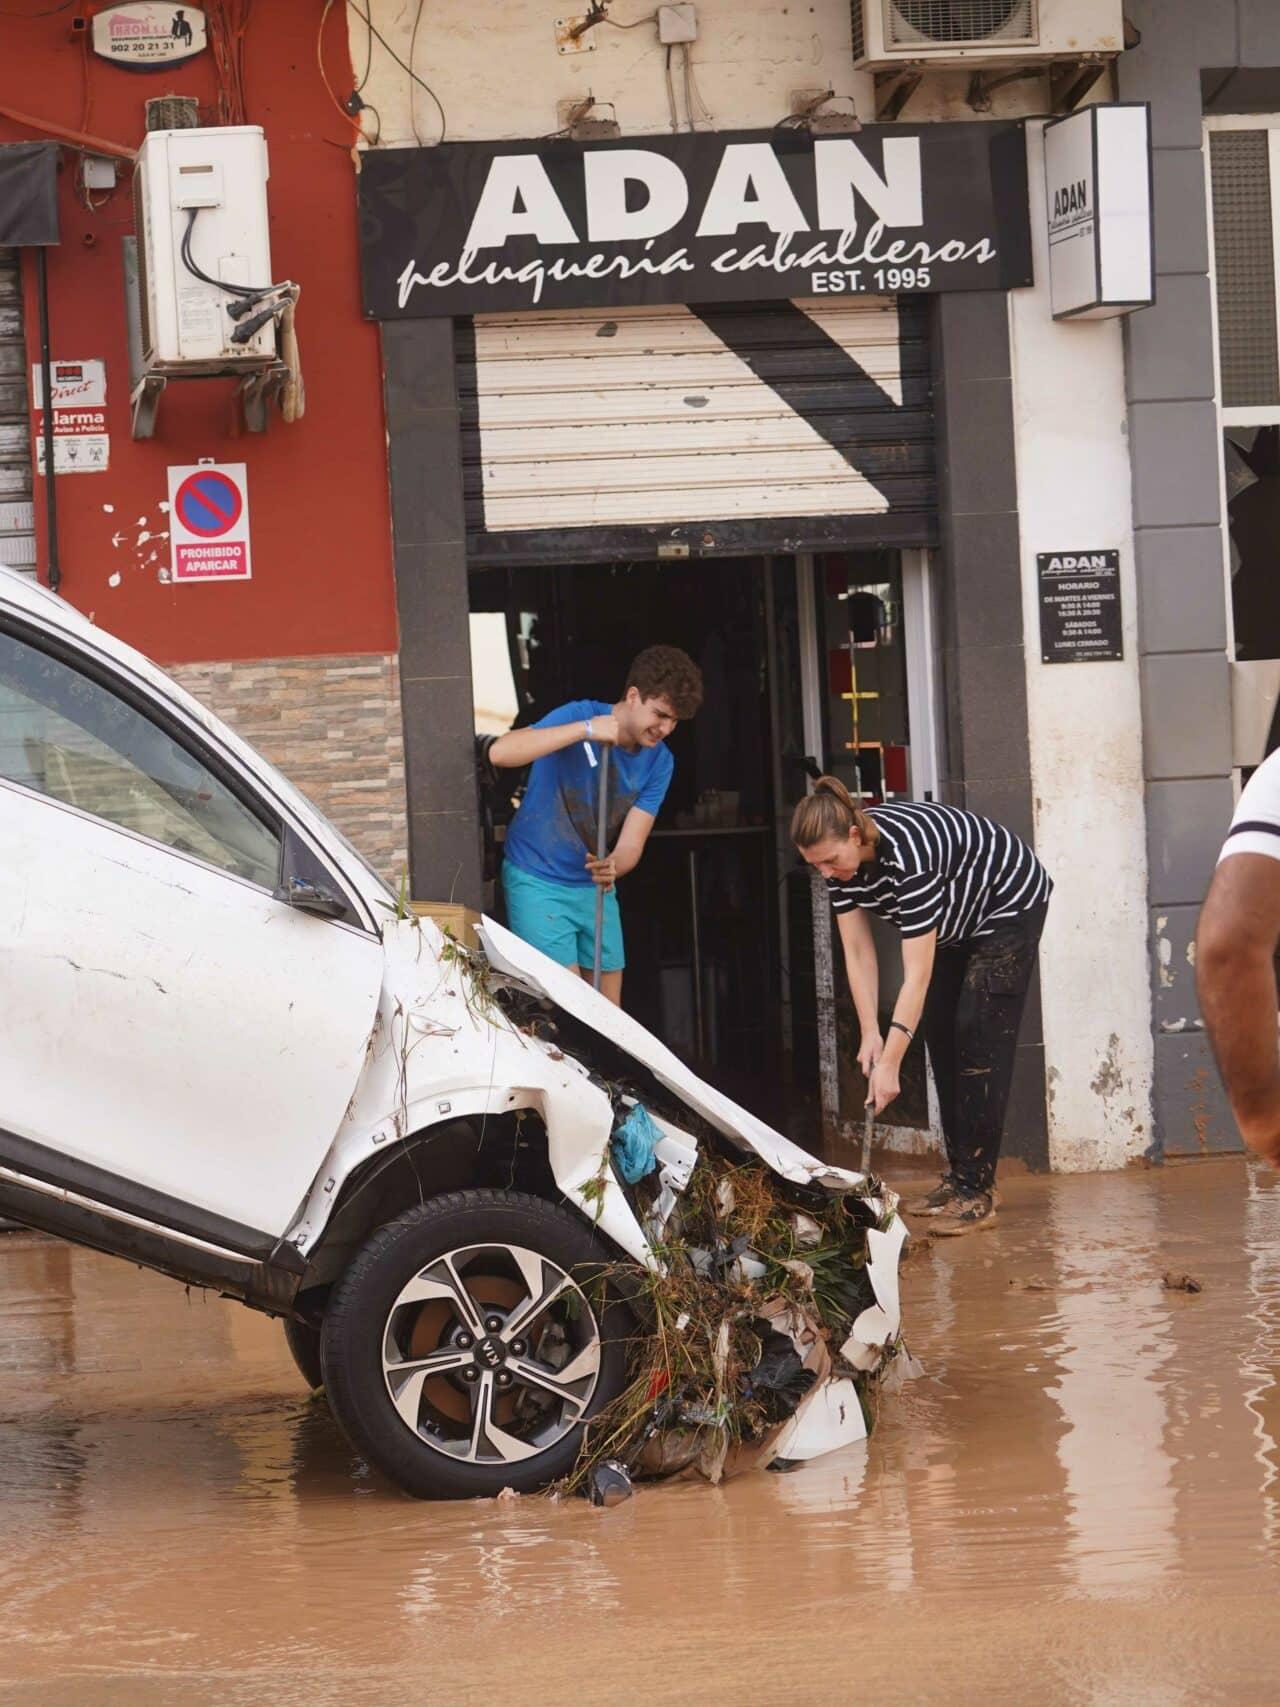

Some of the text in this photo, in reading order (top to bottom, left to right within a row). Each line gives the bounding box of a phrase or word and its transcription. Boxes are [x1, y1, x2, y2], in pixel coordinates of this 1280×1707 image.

[111, 41, 174, 52] 902 20 21 31
[463, 136, 923, 249] ADAN
[1054, 179, 1086, 219] ADAN
[397, 220, 996, 308] peluquería caballeros
[811, 267, 931, 293] EST. 1995
[180, 546, 242, 559] PROHIBIDO
[186, 560, 238, 572] APARCAR
[1048, 556, 1106, 570] ADAN
[1058, 582, 1099, 590] HORARIO
[1054, 594, 1081, 602] MARTES
